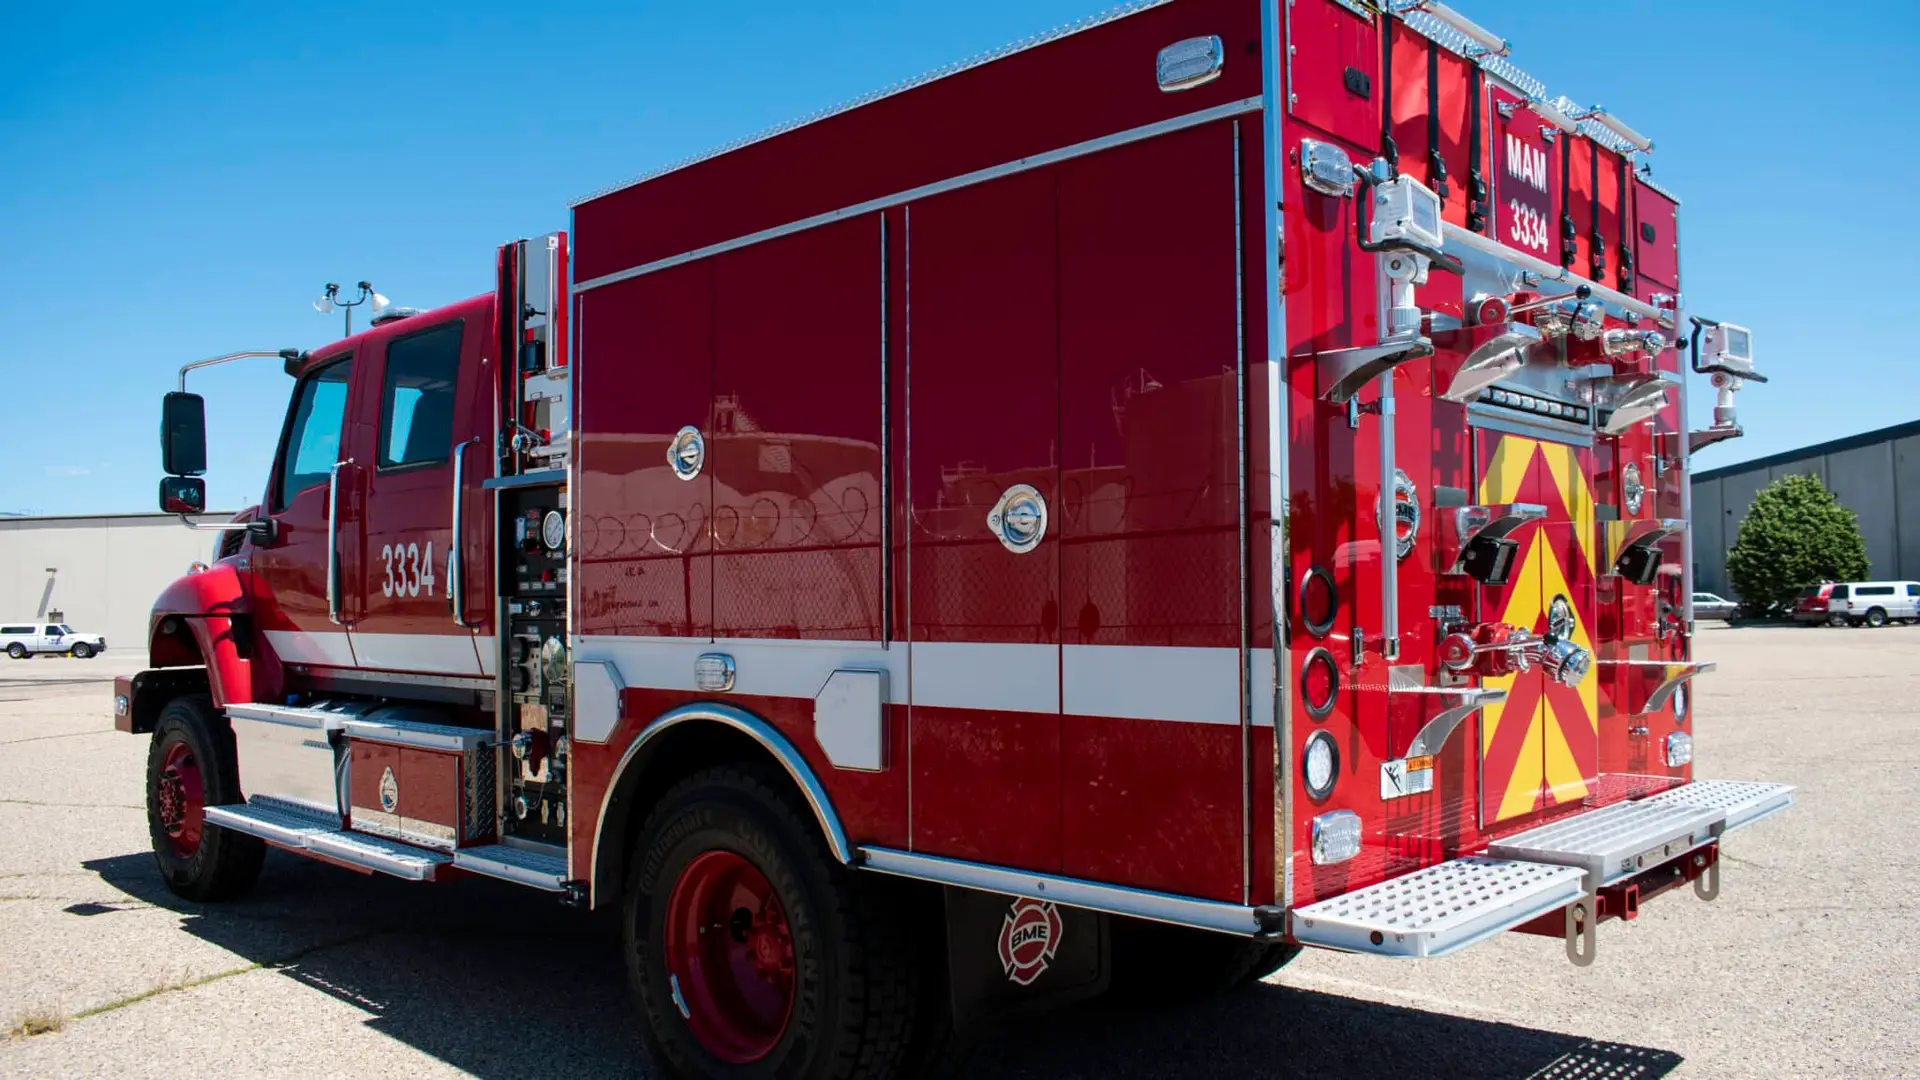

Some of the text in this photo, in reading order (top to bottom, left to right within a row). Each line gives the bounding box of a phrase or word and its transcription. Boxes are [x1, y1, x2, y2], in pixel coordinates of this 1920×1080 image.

[1507, 133, 1547, 194] MAM
[1511, 198, 1548, 254] 3334
[382, 541, 435, 598] 3334
[1011, 924, 1048, 948] BME
